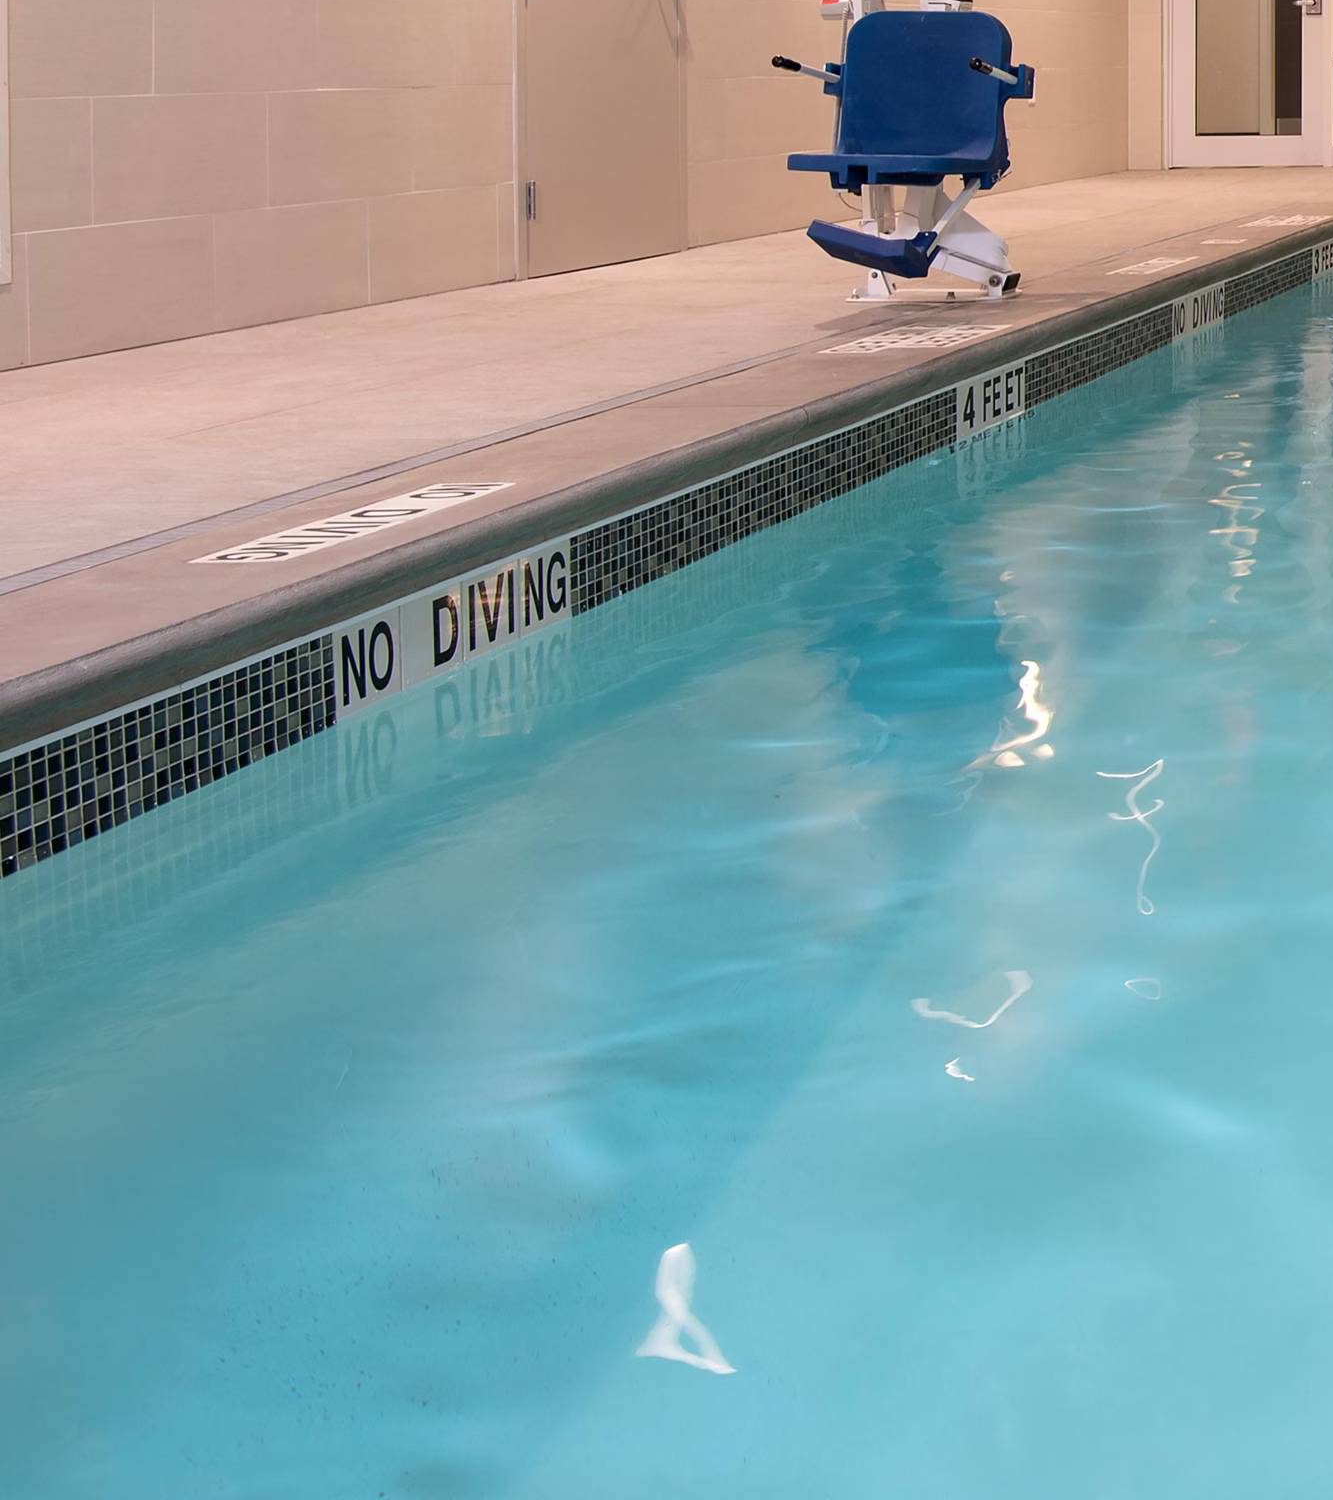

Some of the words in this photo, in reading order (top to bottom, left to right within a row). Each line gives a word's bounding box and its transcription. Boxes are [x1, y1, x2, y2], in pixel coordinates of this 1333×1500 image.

[1315, 249, 1320, 274] 3
[1174, 302, 1185, 337] NO
[1193, 287, 1224, 329] DIVING
[963, 386, 975, 429] 4
[983, 367, 1024, 422] FEET
[410, 483, 505, 500] NO
[214, 508, 428, 561] DIVING
[341, 621, 395, 707] NO
[432, 551, 567, 668] DIVING
